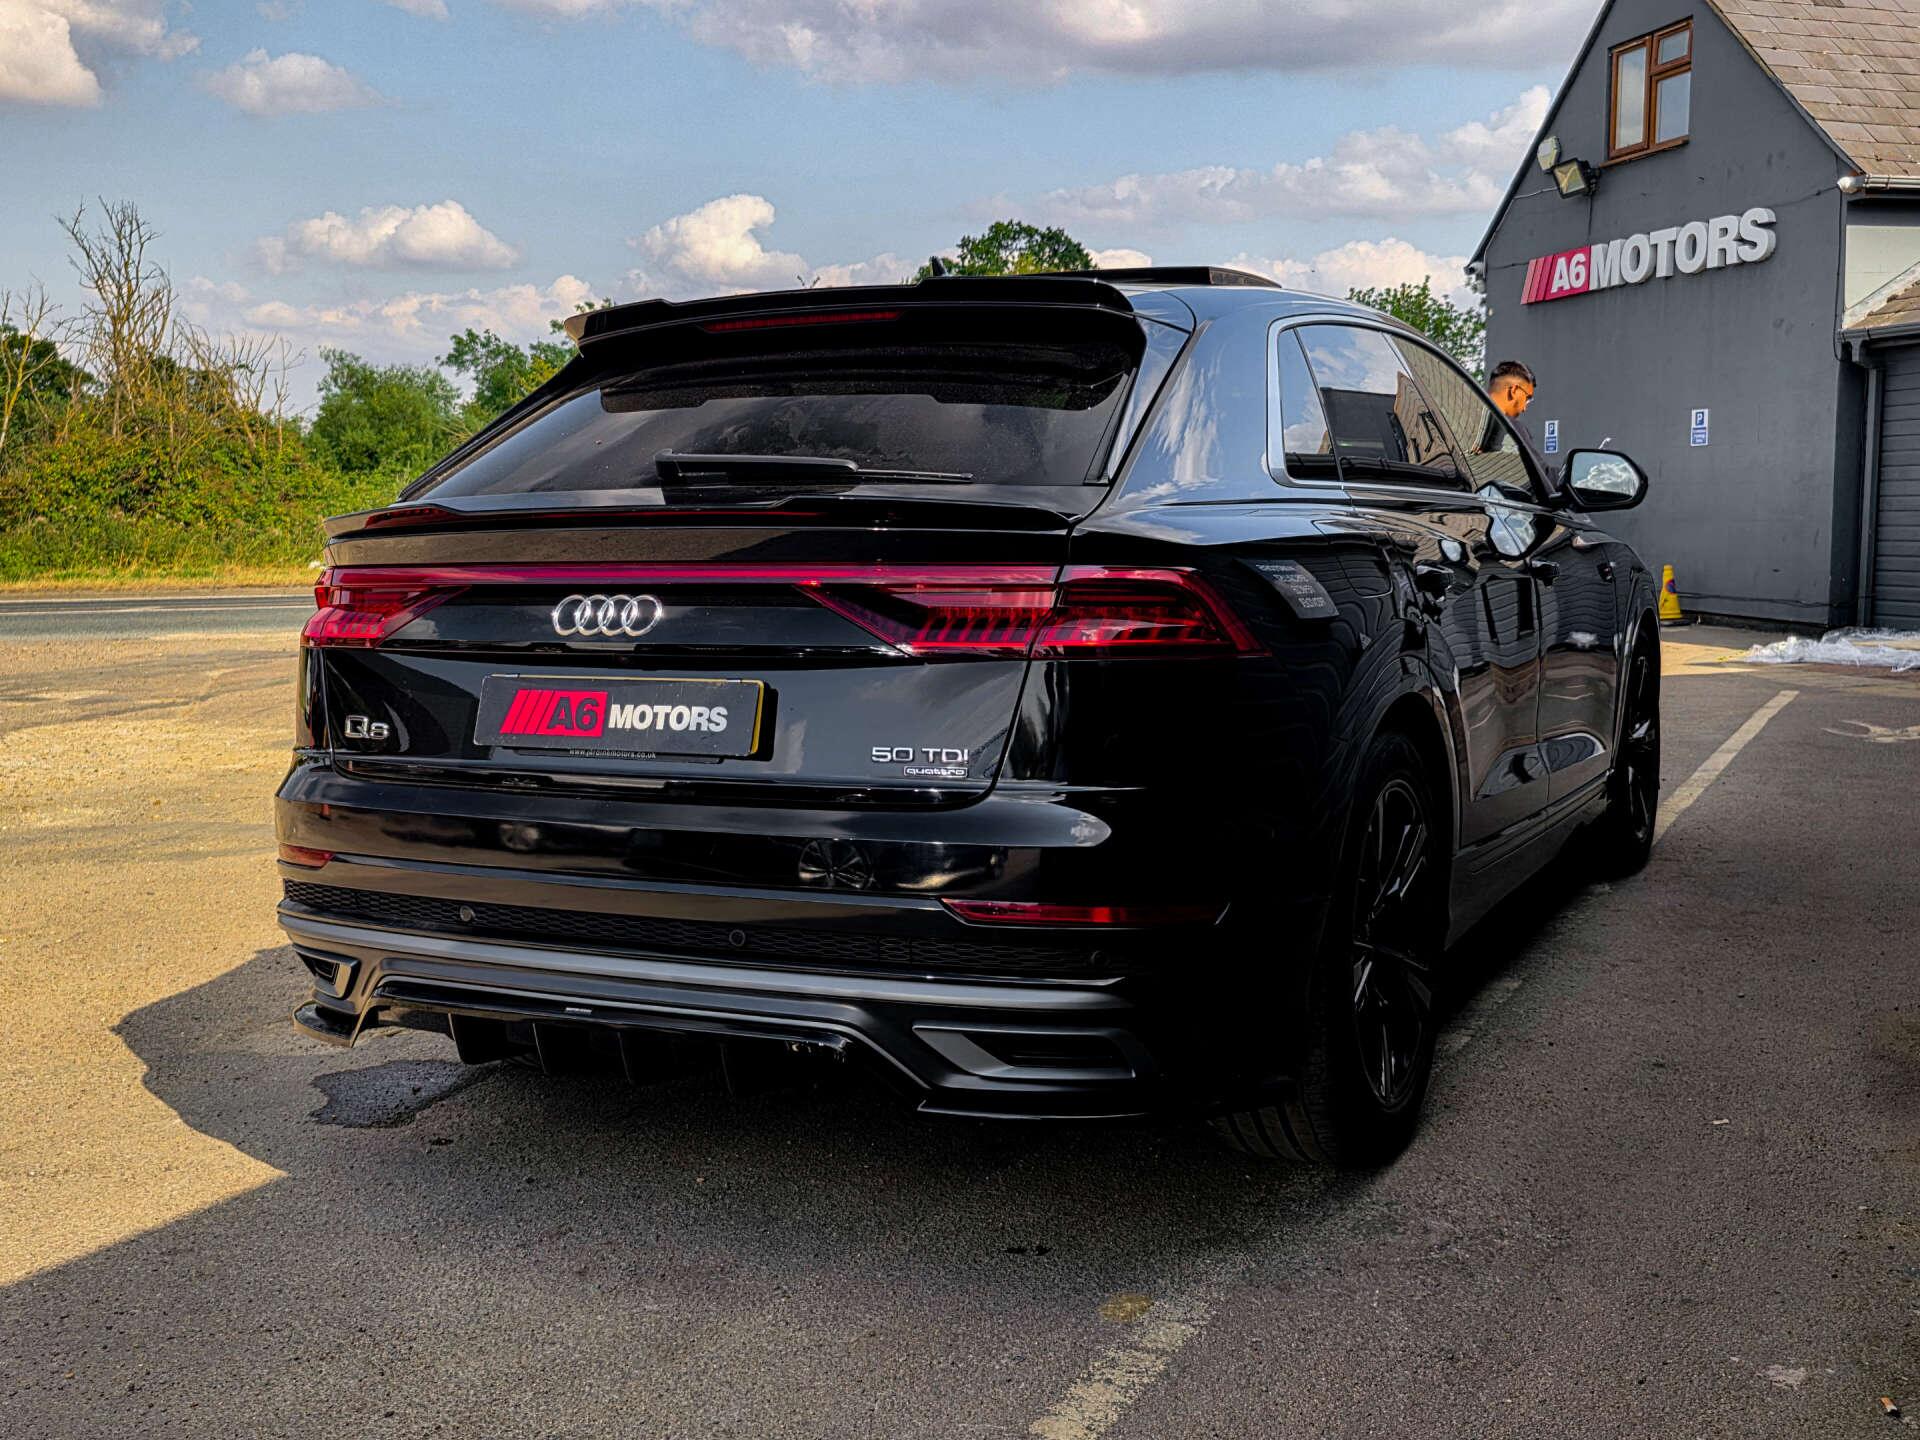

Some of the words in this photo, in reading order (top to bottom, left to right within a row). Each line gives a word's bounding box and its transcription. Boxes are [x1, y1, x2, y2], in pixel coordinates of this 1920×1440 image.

[1550, 253, 1586, 293] A6
[1589, 207, 1777, 291] MOTORS
[1696, 412, 1703, 425] P
[546, 696, 600, 731] A6
[608, 703, 729, 733] MOTORS
[344, 714, 390, 740] Q8
[871, 746, 914, 762] 50
[921, 747, 969, 764] TDI
[905, 767, 965, 776] quattro
